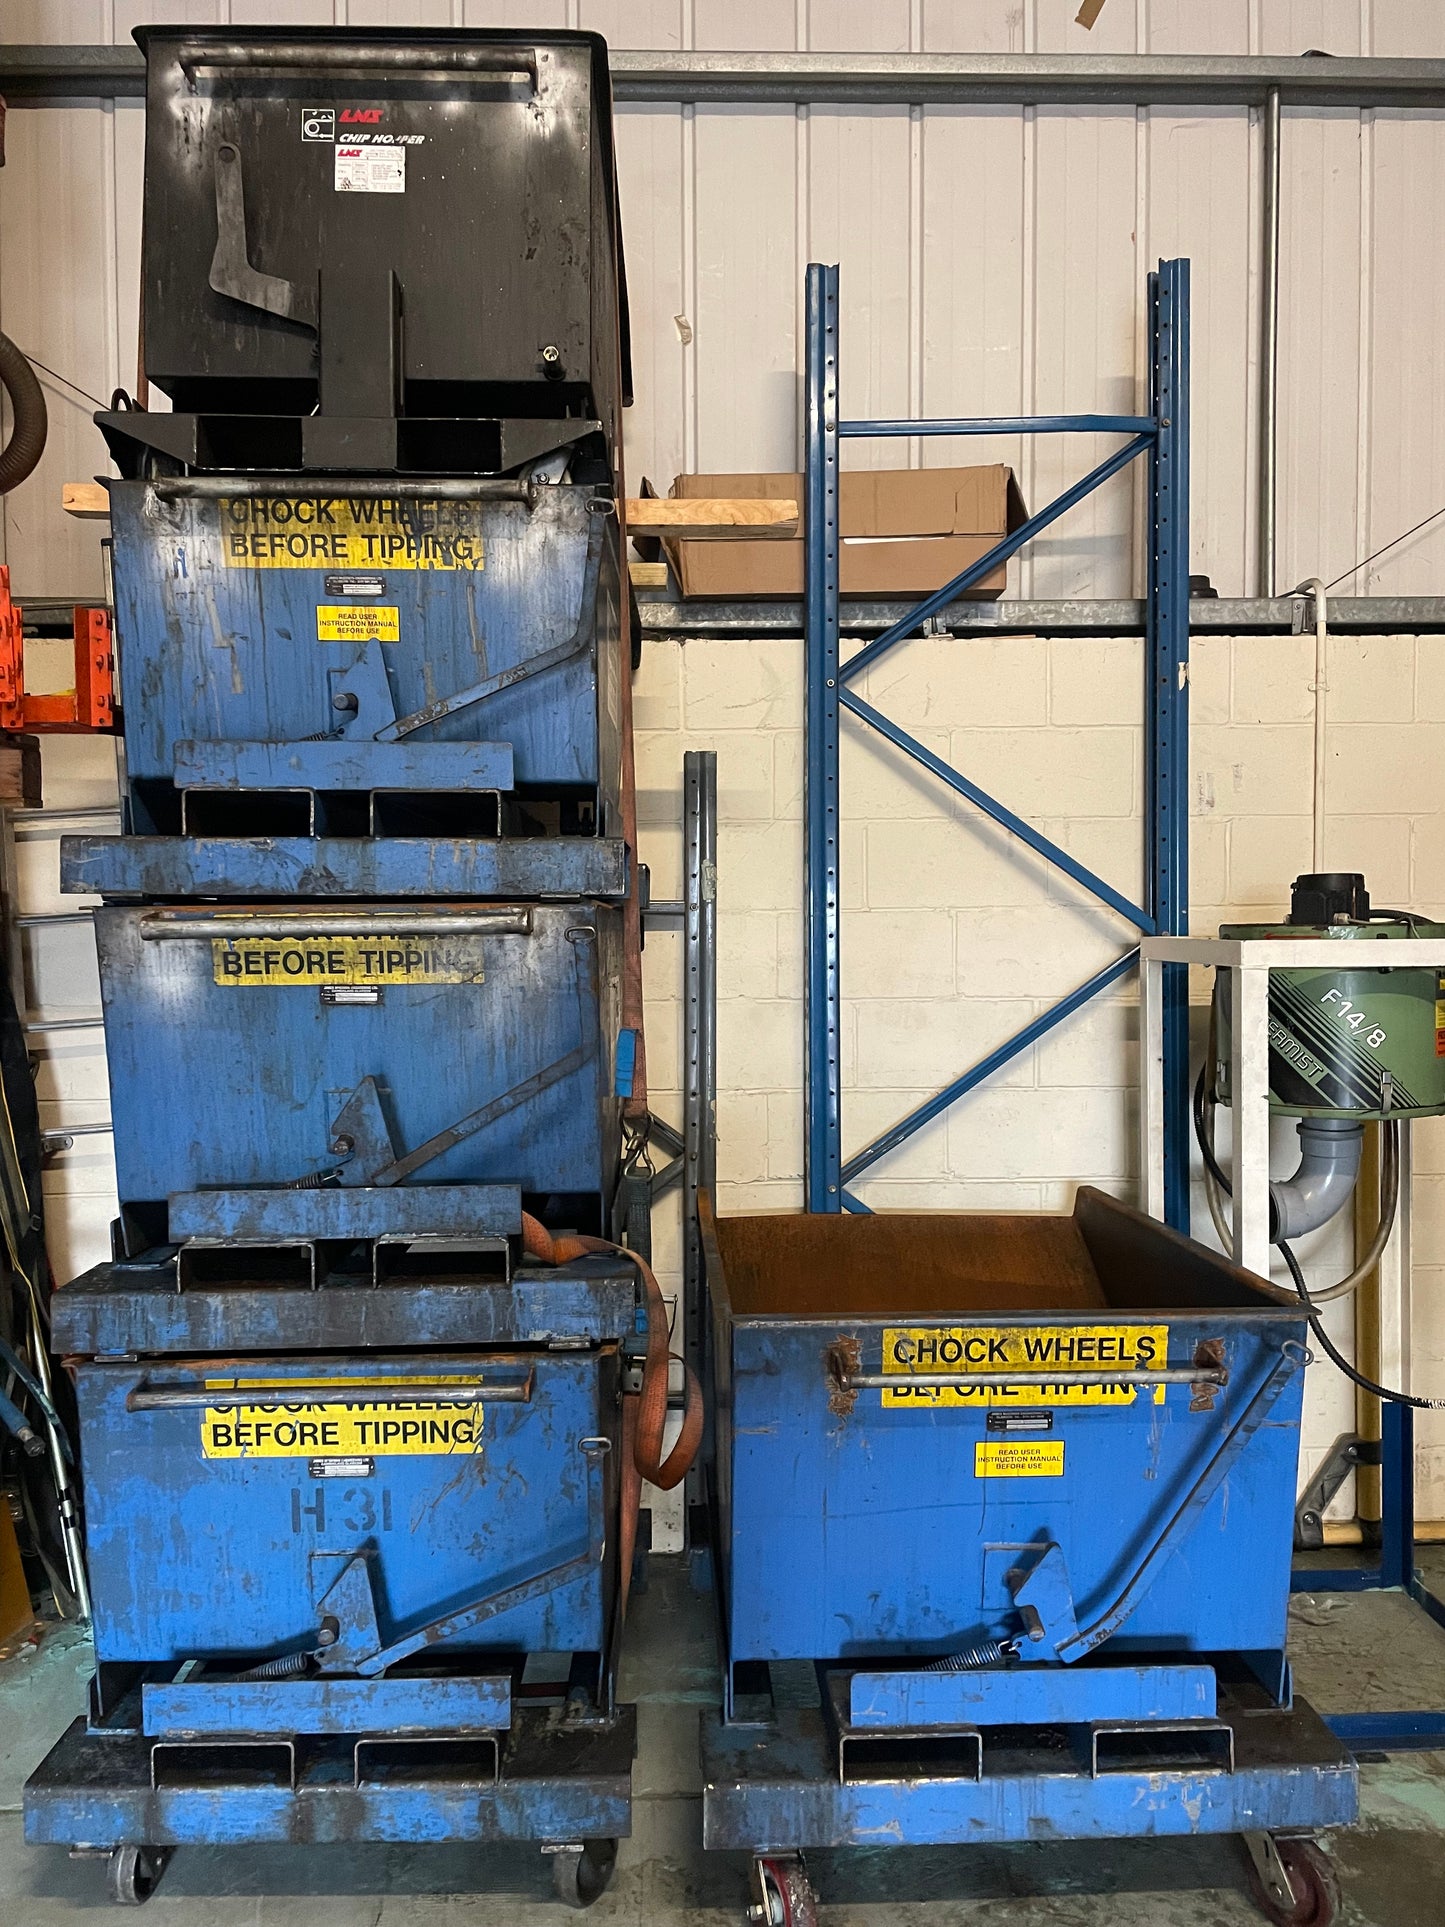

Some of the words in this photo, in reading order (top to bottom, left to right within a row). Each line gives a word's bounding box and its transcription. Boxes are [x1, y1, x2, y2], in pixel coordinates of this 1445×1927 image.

[339, 109, 384, 123] LNS
[339, 133, 371, 143] CHIP
[229, 499, 336, 524] CHOCK
[230, 533, 348, 558] BEFORE
[367, 620, 398, 628] MANUAL
[222, 950, 345, 976] BEFORE
[359, 950, 476, 975] TIPPING
[1320, 988, 1387, 1049] F14/8
[1268, 1018, 1324, 1078] ERMIST
[893, 1337, 1009, 1364] CHOCK
[1024, 1335, 1156, 1362] WHEELS
[212, 1421, 339, 1448] BEFORE
[354, 1419, 474, 1446] TIPPING
